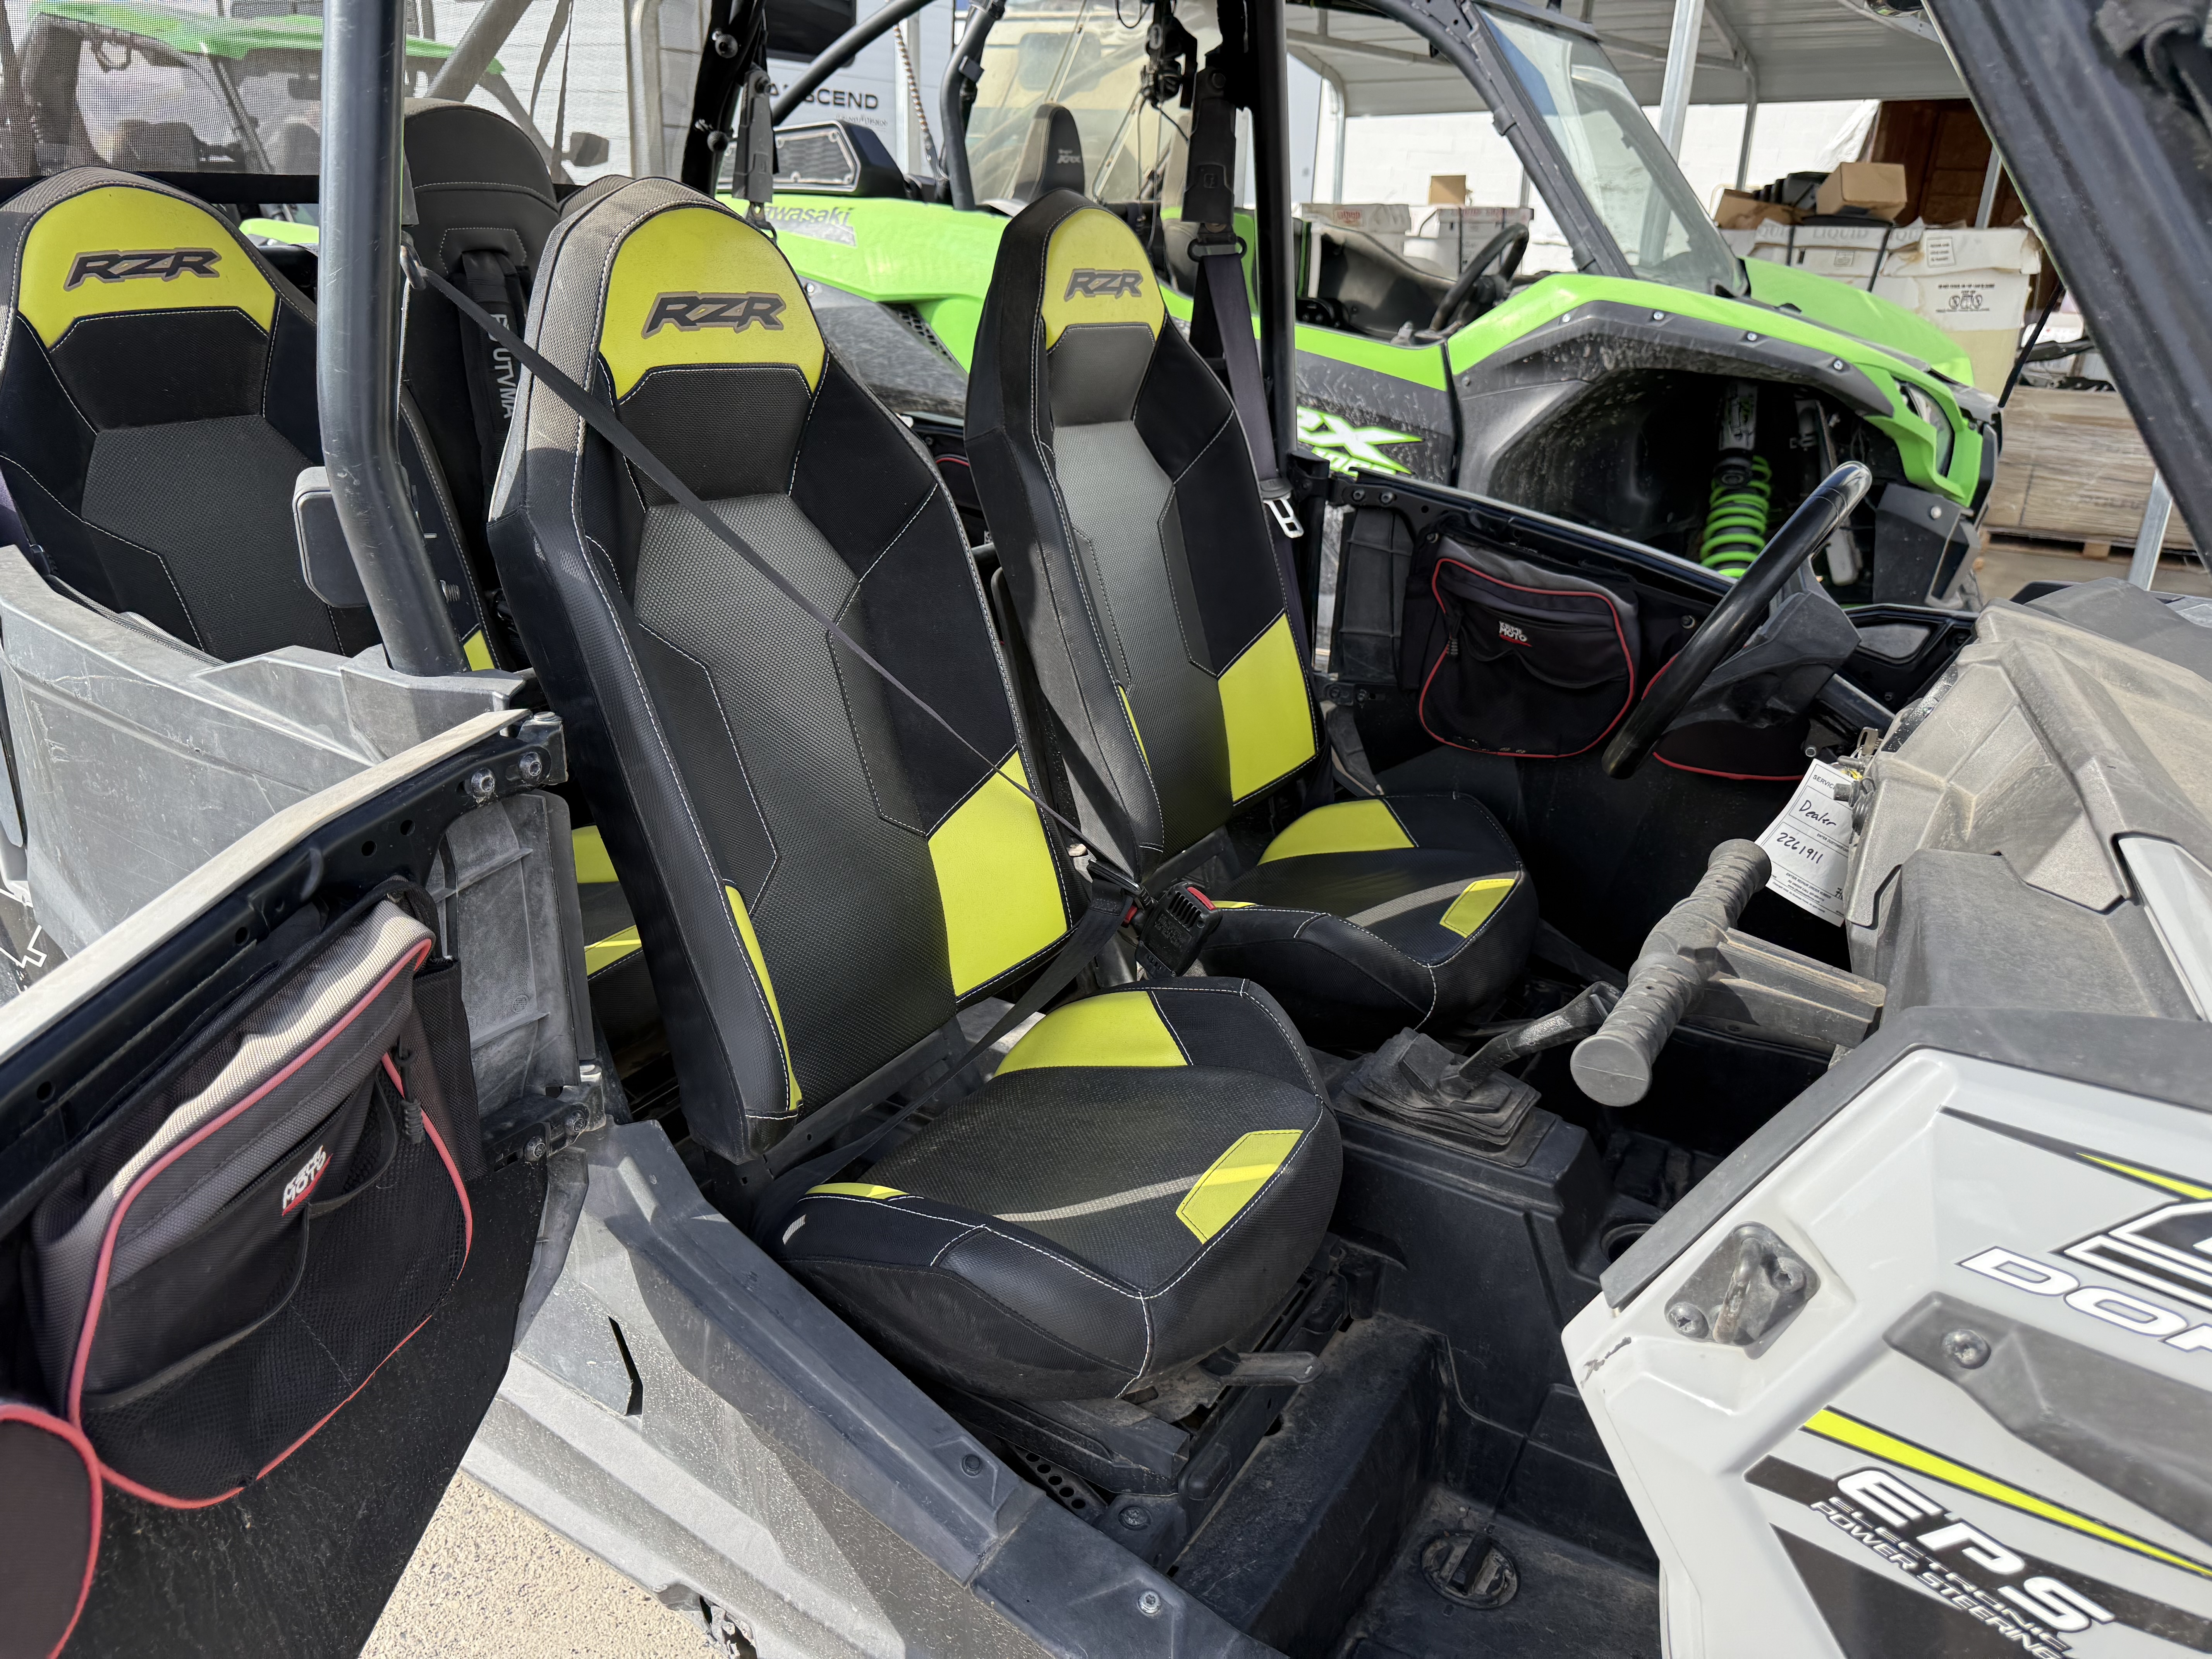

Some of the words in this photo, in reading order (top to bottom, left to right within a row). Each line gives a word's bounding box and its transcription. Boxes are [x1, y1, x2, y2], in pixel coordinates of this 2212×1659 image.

[764, 206, 855, 225] wasaki
[63, 247, 222, 292] RZR
[1064, 268, 1144, 302] RZR
[641, 291, 787, 340] RZR
[1499, 627, 1528, 642] MOTO
[1813, 775, 1835, 790] SERVIC
[1799, 799, 1836, 826] Dealer
[1810, 1501, 1918, 1569] POWER
[1837, 1470, 2116, 1633] EPS
[1829, 1496, 2072, 1652] ELECTRONIC
